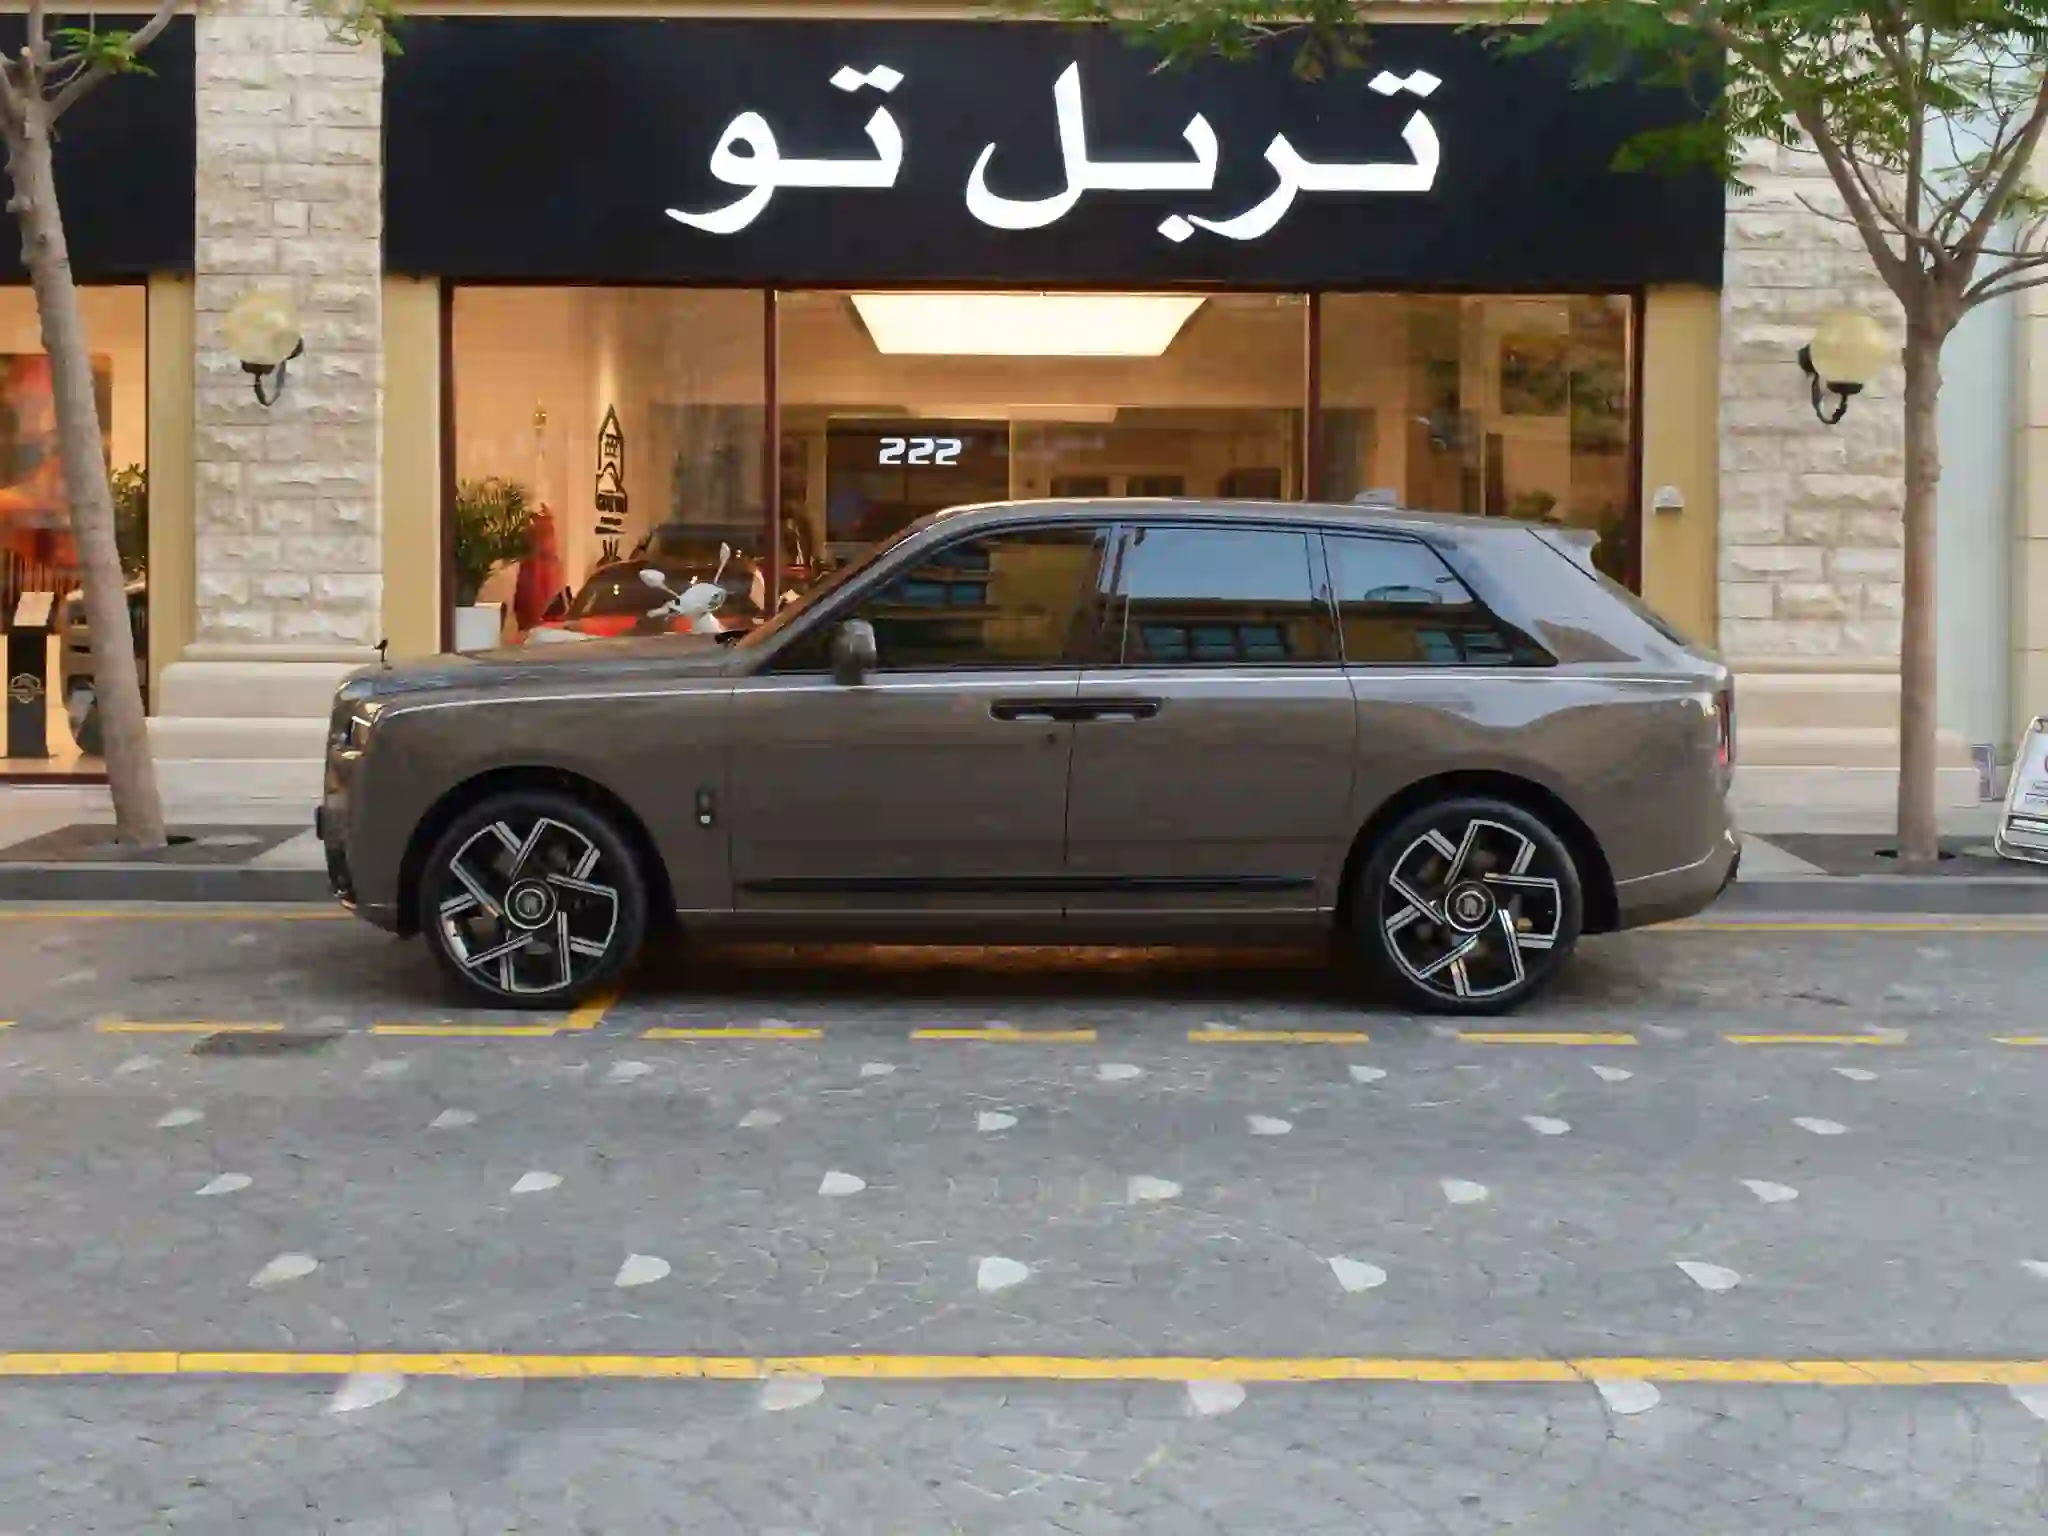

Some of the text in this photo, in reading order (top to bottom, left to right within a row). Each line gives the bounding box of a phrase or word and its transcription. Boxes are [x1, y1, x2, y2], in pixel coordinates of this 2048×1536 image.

[665, 61, 1443, 241] تربل تو
[879, 437, 963, 465] 222
